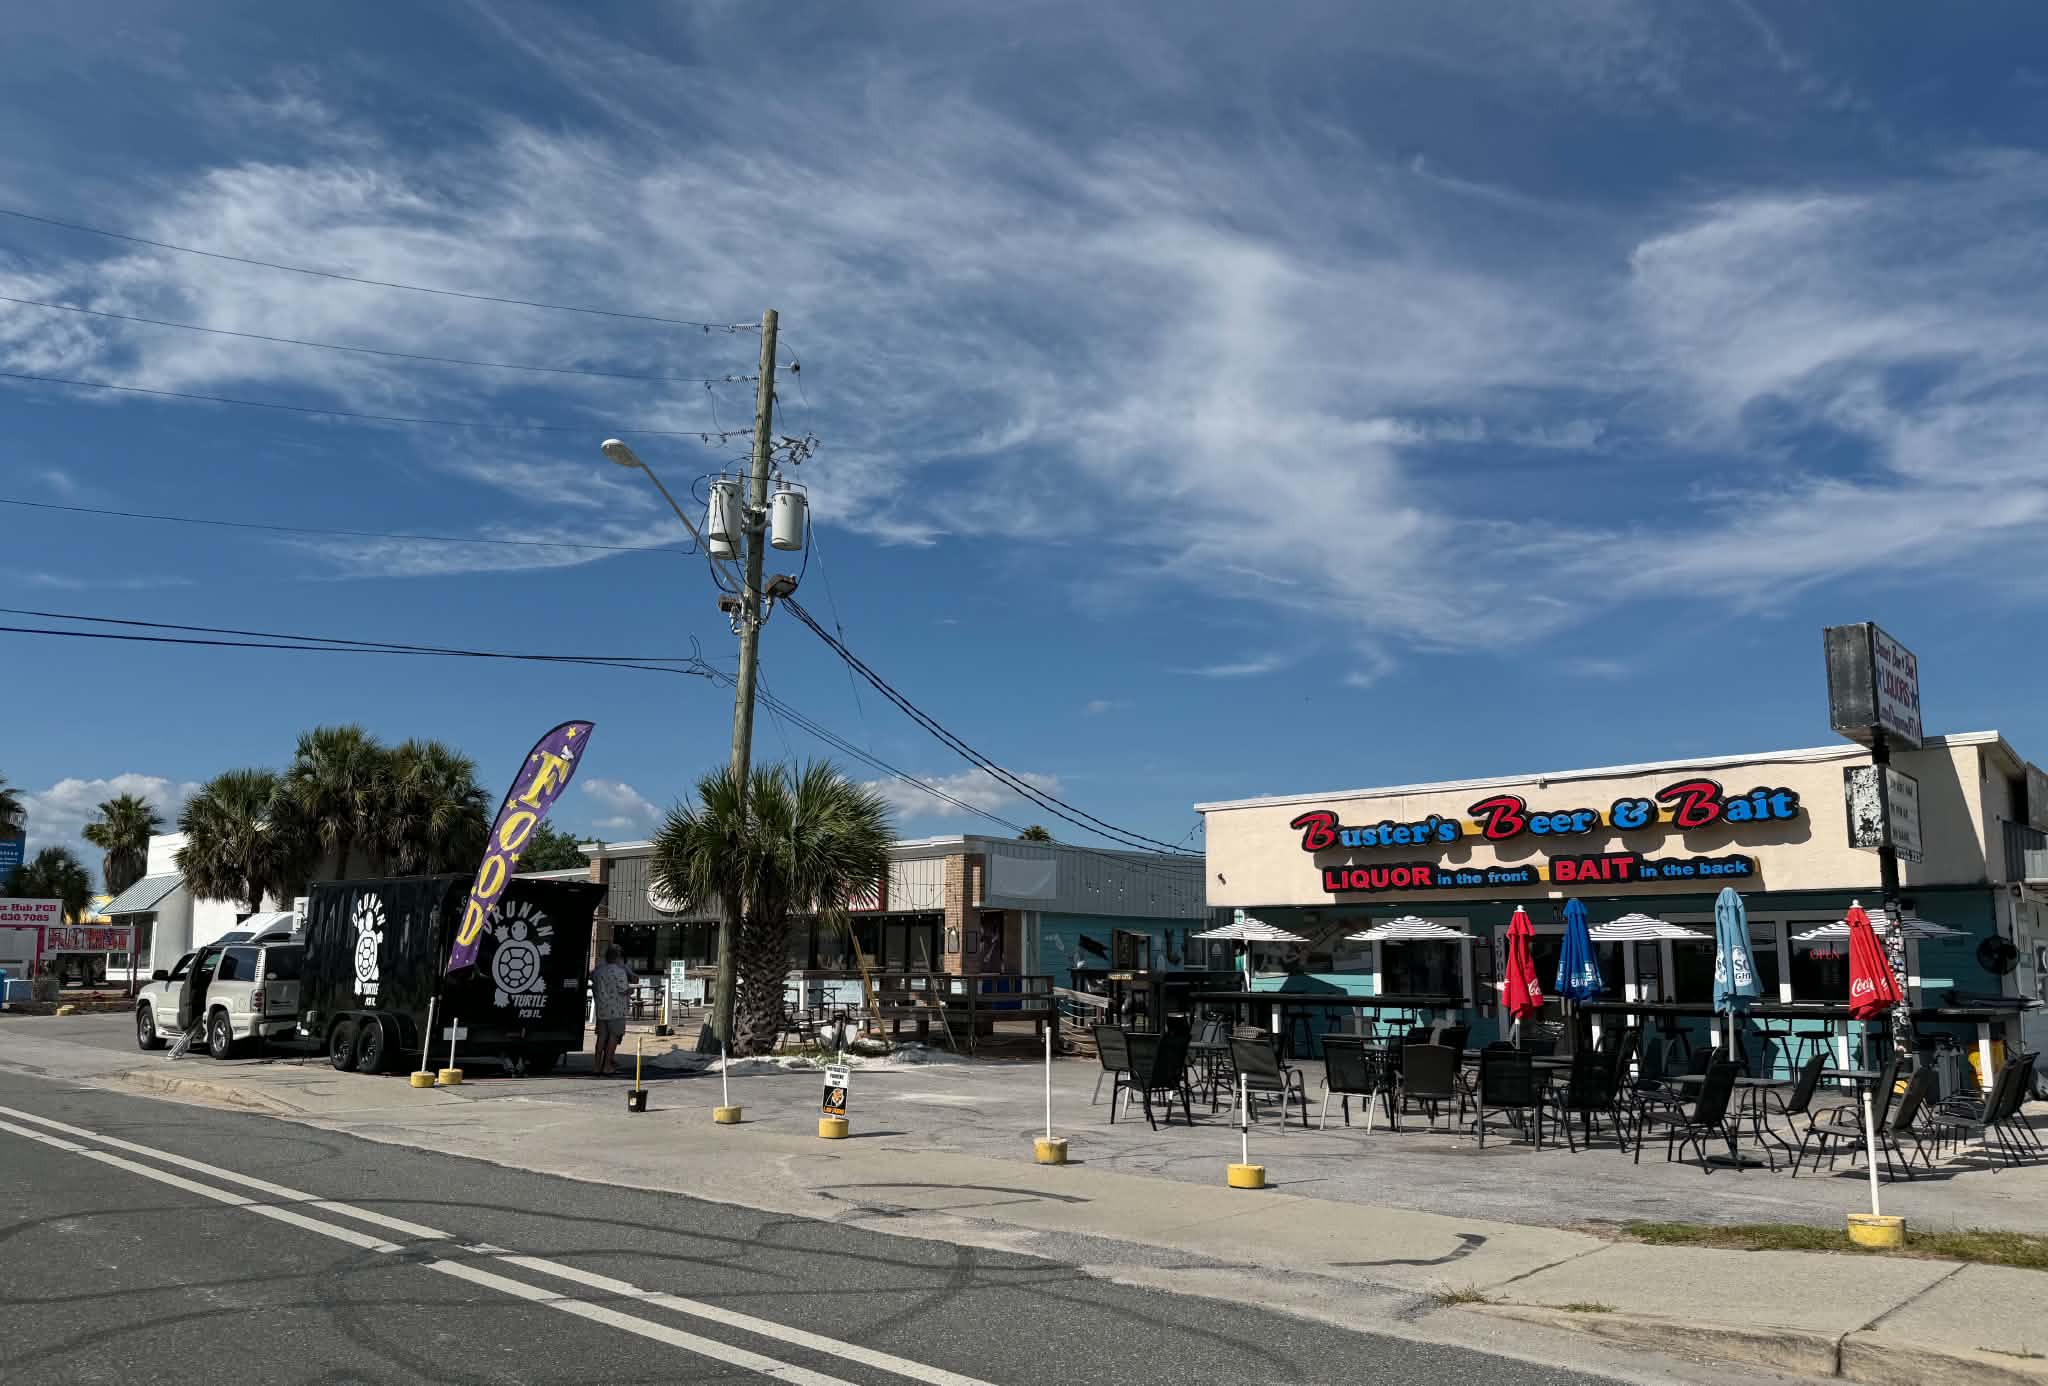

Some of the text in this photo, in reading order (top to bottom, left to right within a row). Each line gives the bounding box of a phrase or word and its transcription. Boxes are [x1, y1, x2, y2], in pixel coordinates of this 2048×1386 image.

[1293, 782, 1794, 851] Buster's Beer & Bait
[457, 750, 571, 946] FOOD
[1325, 866, 1529, 890] LIQUOR in the front
[1555, 857, 1749, 881] BAIT in the back
[35, 904, 57, 912] PCB
[352, 892, 386, 928] DRUNKN
[1809, 949, 1840, 961] OPEN
[510, 994, 549, 1008] TURTLE
